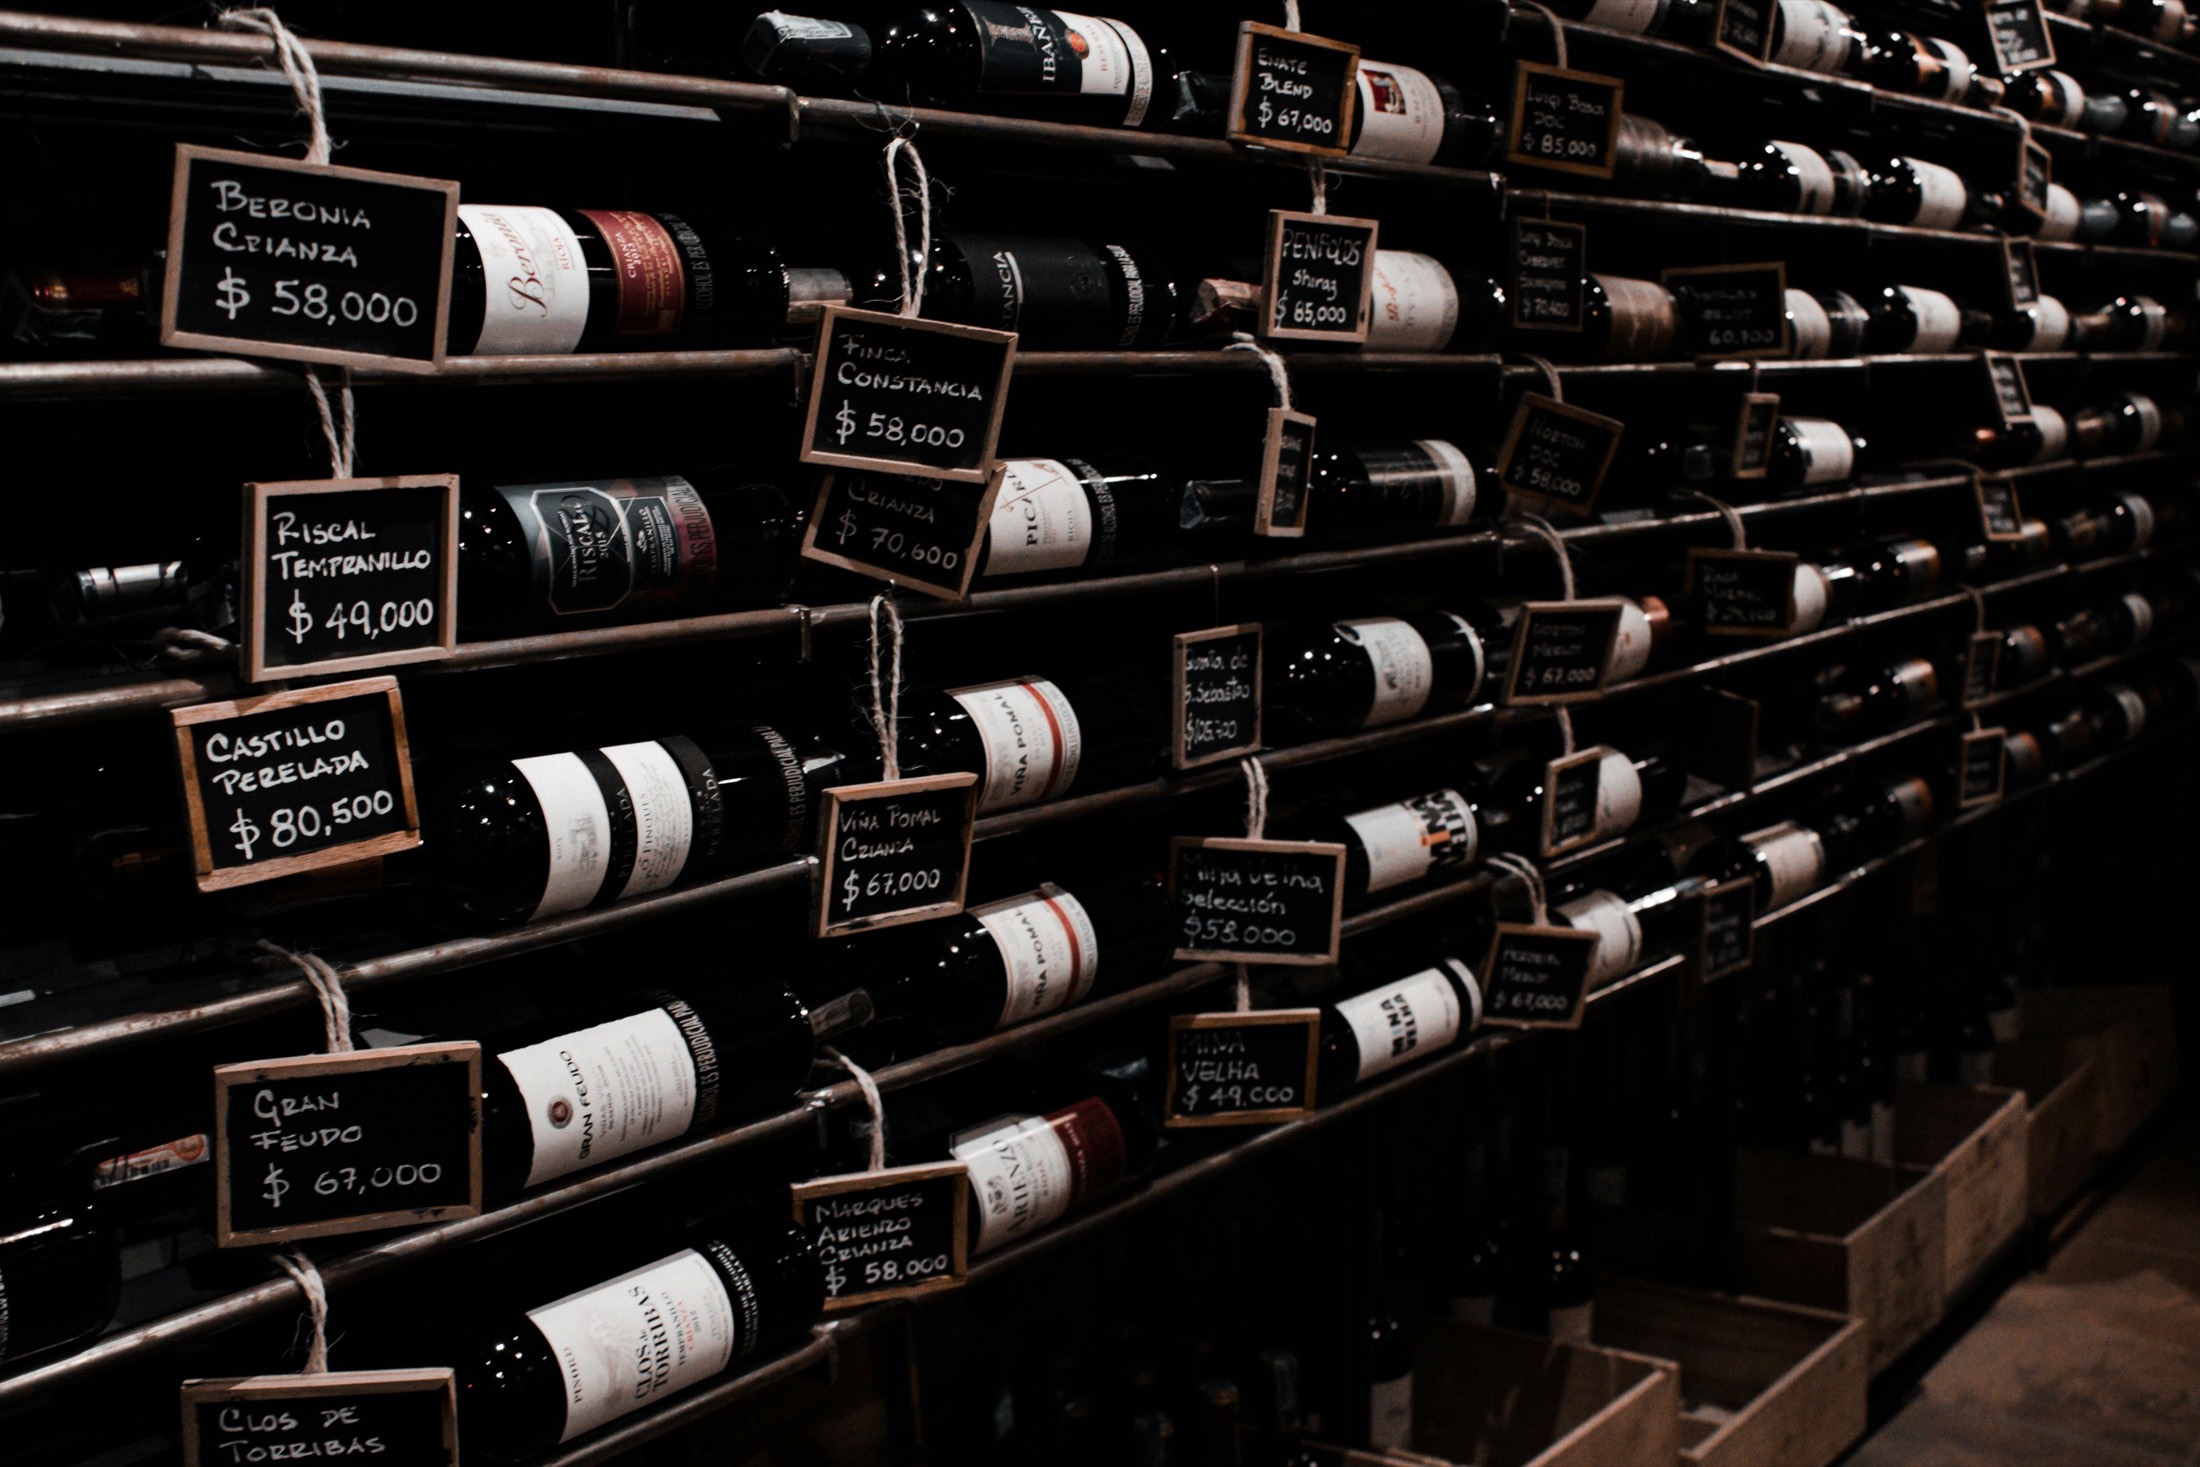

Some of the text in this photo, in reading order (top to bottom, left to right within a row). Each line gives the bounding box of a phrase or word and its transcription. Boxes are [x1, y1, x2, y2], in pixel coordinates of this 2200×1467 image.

[1258, 73, 1313, 99] BLEND
[1277, 109, 1333, 134] 67,000
[210, 180, 371, 230] BERONIA
[212, 221, 358, 269] CRIANZA
[478, 213, 547, 317] Beronia
[615, 232, 636, 278] CRIANZA
[215, 266, 418, 327] $ 58,000
[1292, 268, 1338, 301] Shiraz
[837, 361, 983, 401] CONSTANCIA
[835, 399, 965, 448] $ 58,000
[847, 478, 936, 524] CRIANZA
[272, 511, 376, 546] RISCAL
[572, 514, 597, 581] RISCAL
[870, 526, 959, 570] 70,600
[270, 550, 432, 580] TEMPRANILLO
[285, 588, 434, 644] $ 49,000
[206, 719, 346, 762] CASTILLO
[994, 692, 1028, 795] VIÑA POMAL
[212, 750, 370, 795] PERELADA
[777, 747, 807, 803] PERJUDICIAL
[270, 789, 394, 848] 80,500
[886, 804, 942, 828] POMAL
[1016, 909, 1046, 965] POMAL
[685, 1015, 720, 1070] PERJUDICIAL
[701, 1074, 720, 1083] ES
[1181, 1059, 1260, 1083] VELHA
[253, 1089, 340, 1127] GRAN
[560, 1050, 594, 1160] GRAN FEUDO
[250, 1125, 363, 1152] FEUDO
[262, 1162, 442, 1208] $ 67,000
[628, 1285, 670, 1392] TORRIBAS
[660, 1290, 687, 1366] TEMPRANILLO
[563, 1345, 583, 1403] PINORD
[636, 1327, 654, 1400] CLOS de
[218, 1406, 360, 1432] CLOS DE
[217, 1436, 386, 1463] TORRIBAS
